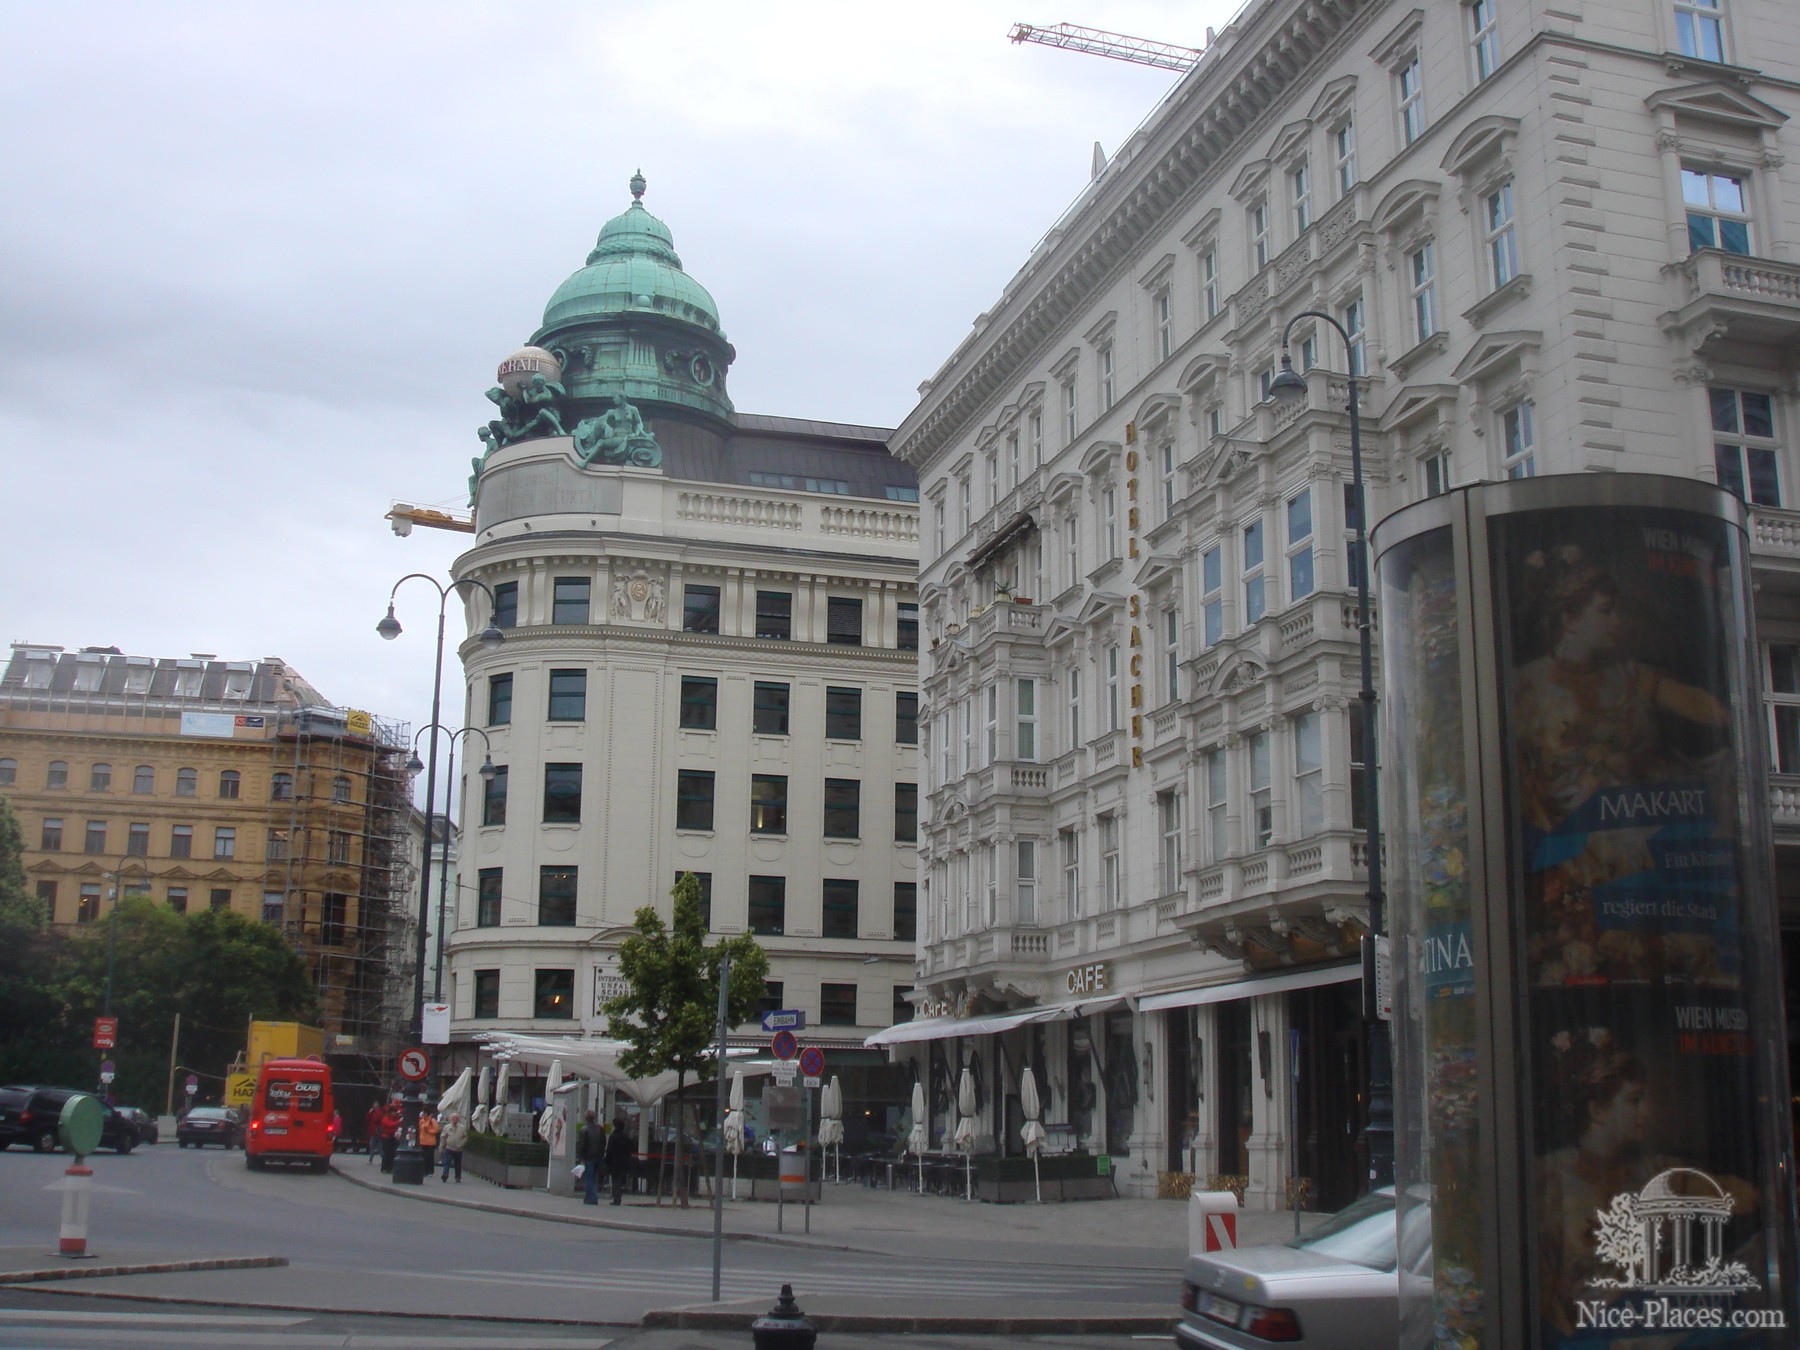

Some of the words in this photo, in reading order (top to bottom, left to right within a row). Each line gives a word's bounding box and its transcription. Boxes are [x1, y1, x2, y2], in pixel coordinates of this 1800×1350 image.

[1125, 420, 1140, 560] HOTEL
[1129, 594, 1144, 769] SACHER
[1600, 790, 1706, 821] MAKART
[1664, 852, 1689, 869] Ein
[1602, 899, 1657, 918] regiert
[1661, 900, 1685, 917] die
[1687, 902, 1717, 920] Stadt
[773, 1015, 796, 1026] EINBAHN
[1675, 1006, 1712, 1030] WIEN
[269, 1089, 292, 1098] city
[295, 1083, 320, 1092] bus
